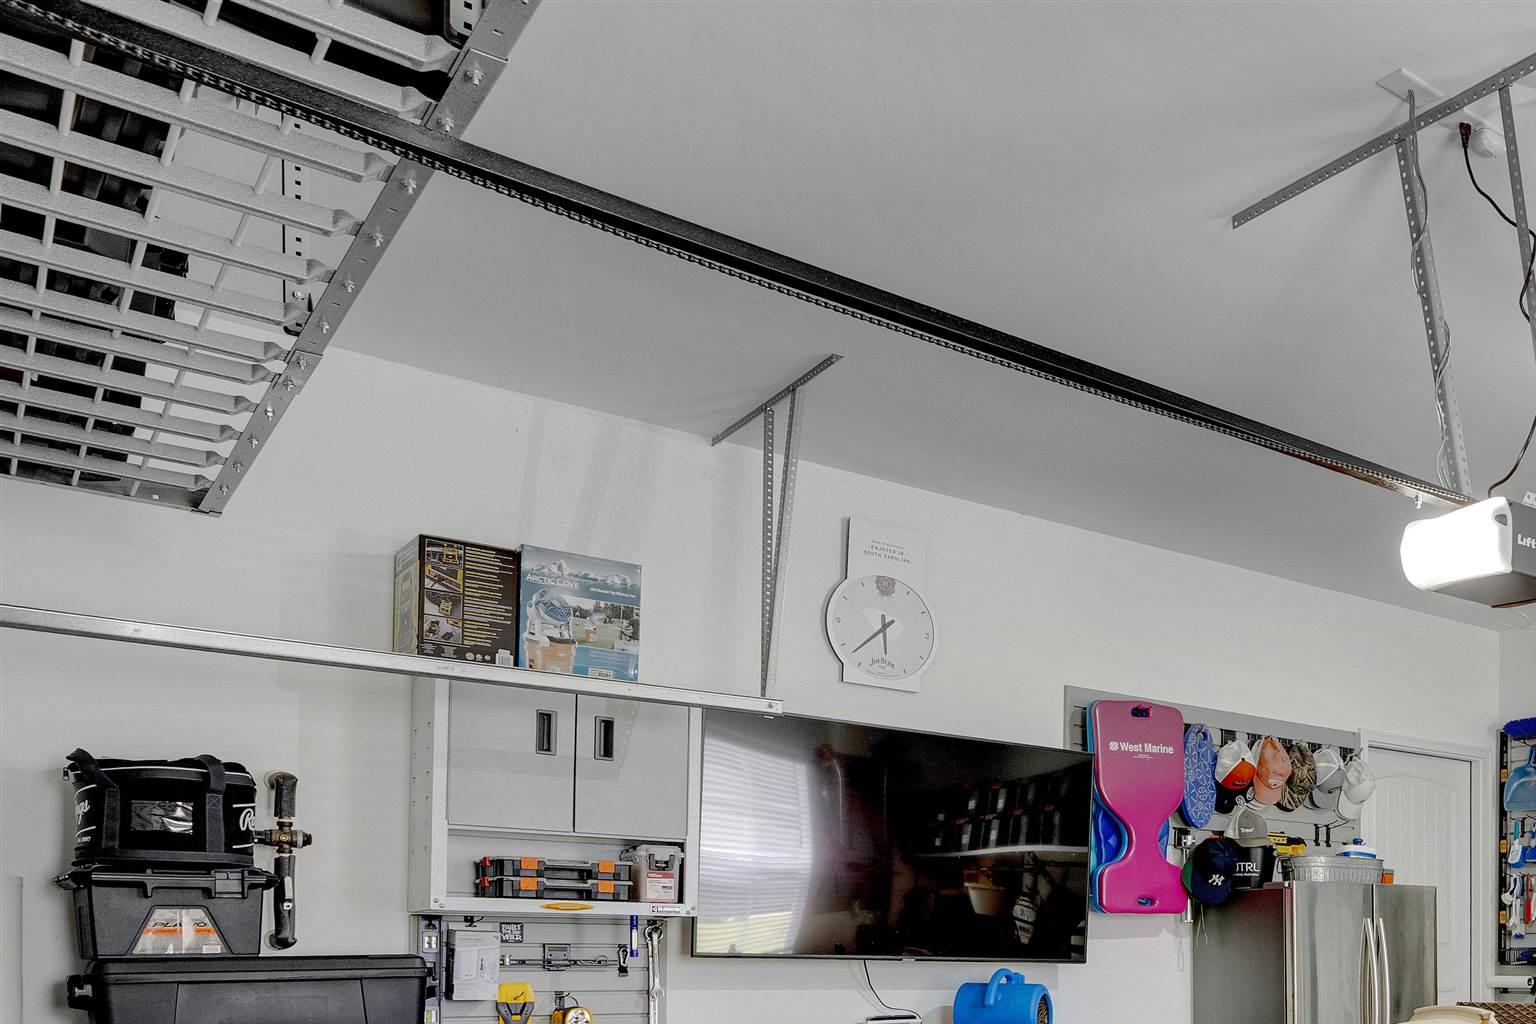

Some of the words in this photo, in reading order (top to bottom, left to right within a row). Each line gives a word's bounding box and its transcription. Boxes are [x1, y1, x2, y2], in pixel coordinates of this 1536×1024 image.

[526, 572, 555, 586] ARCTIC
[1119, 741, 1143, 752] West
[1144, 743, 1175, 754] Marine
[152, 921, 208, 929] PLAO
